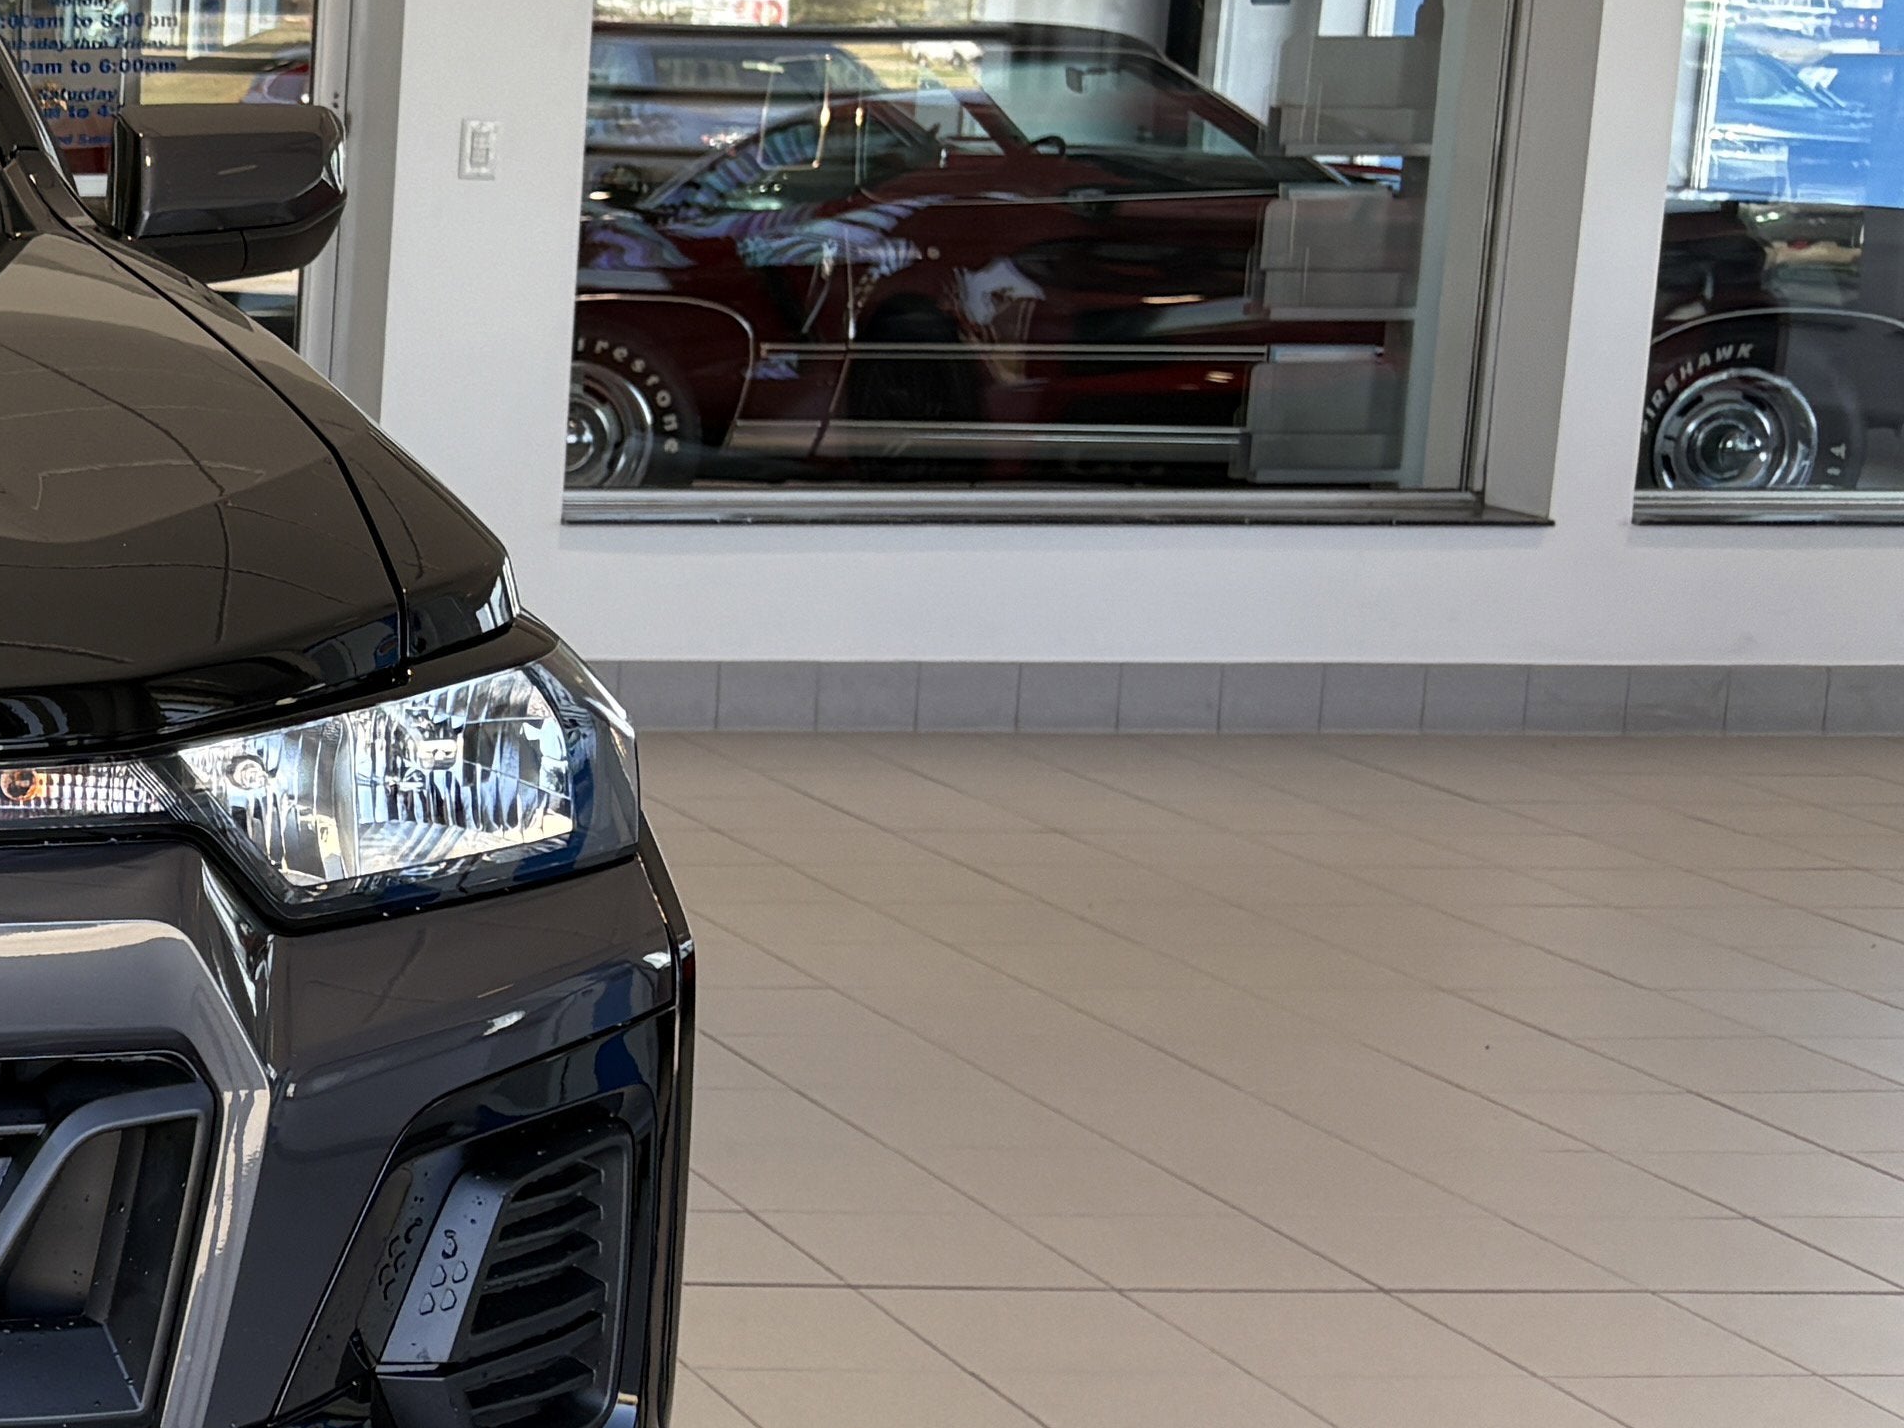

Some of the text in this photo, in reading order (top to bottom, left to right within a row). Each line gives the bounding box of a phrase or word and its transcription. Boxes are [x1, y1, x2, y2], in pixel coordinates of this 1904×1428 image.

[73, 14, 93, 29] to
[71, 59, 92, 74] to
[99, 58, 178, 76] 6:00pm
[69, 105, 90, 119] to
[576, 336, 680, 455] irestone
